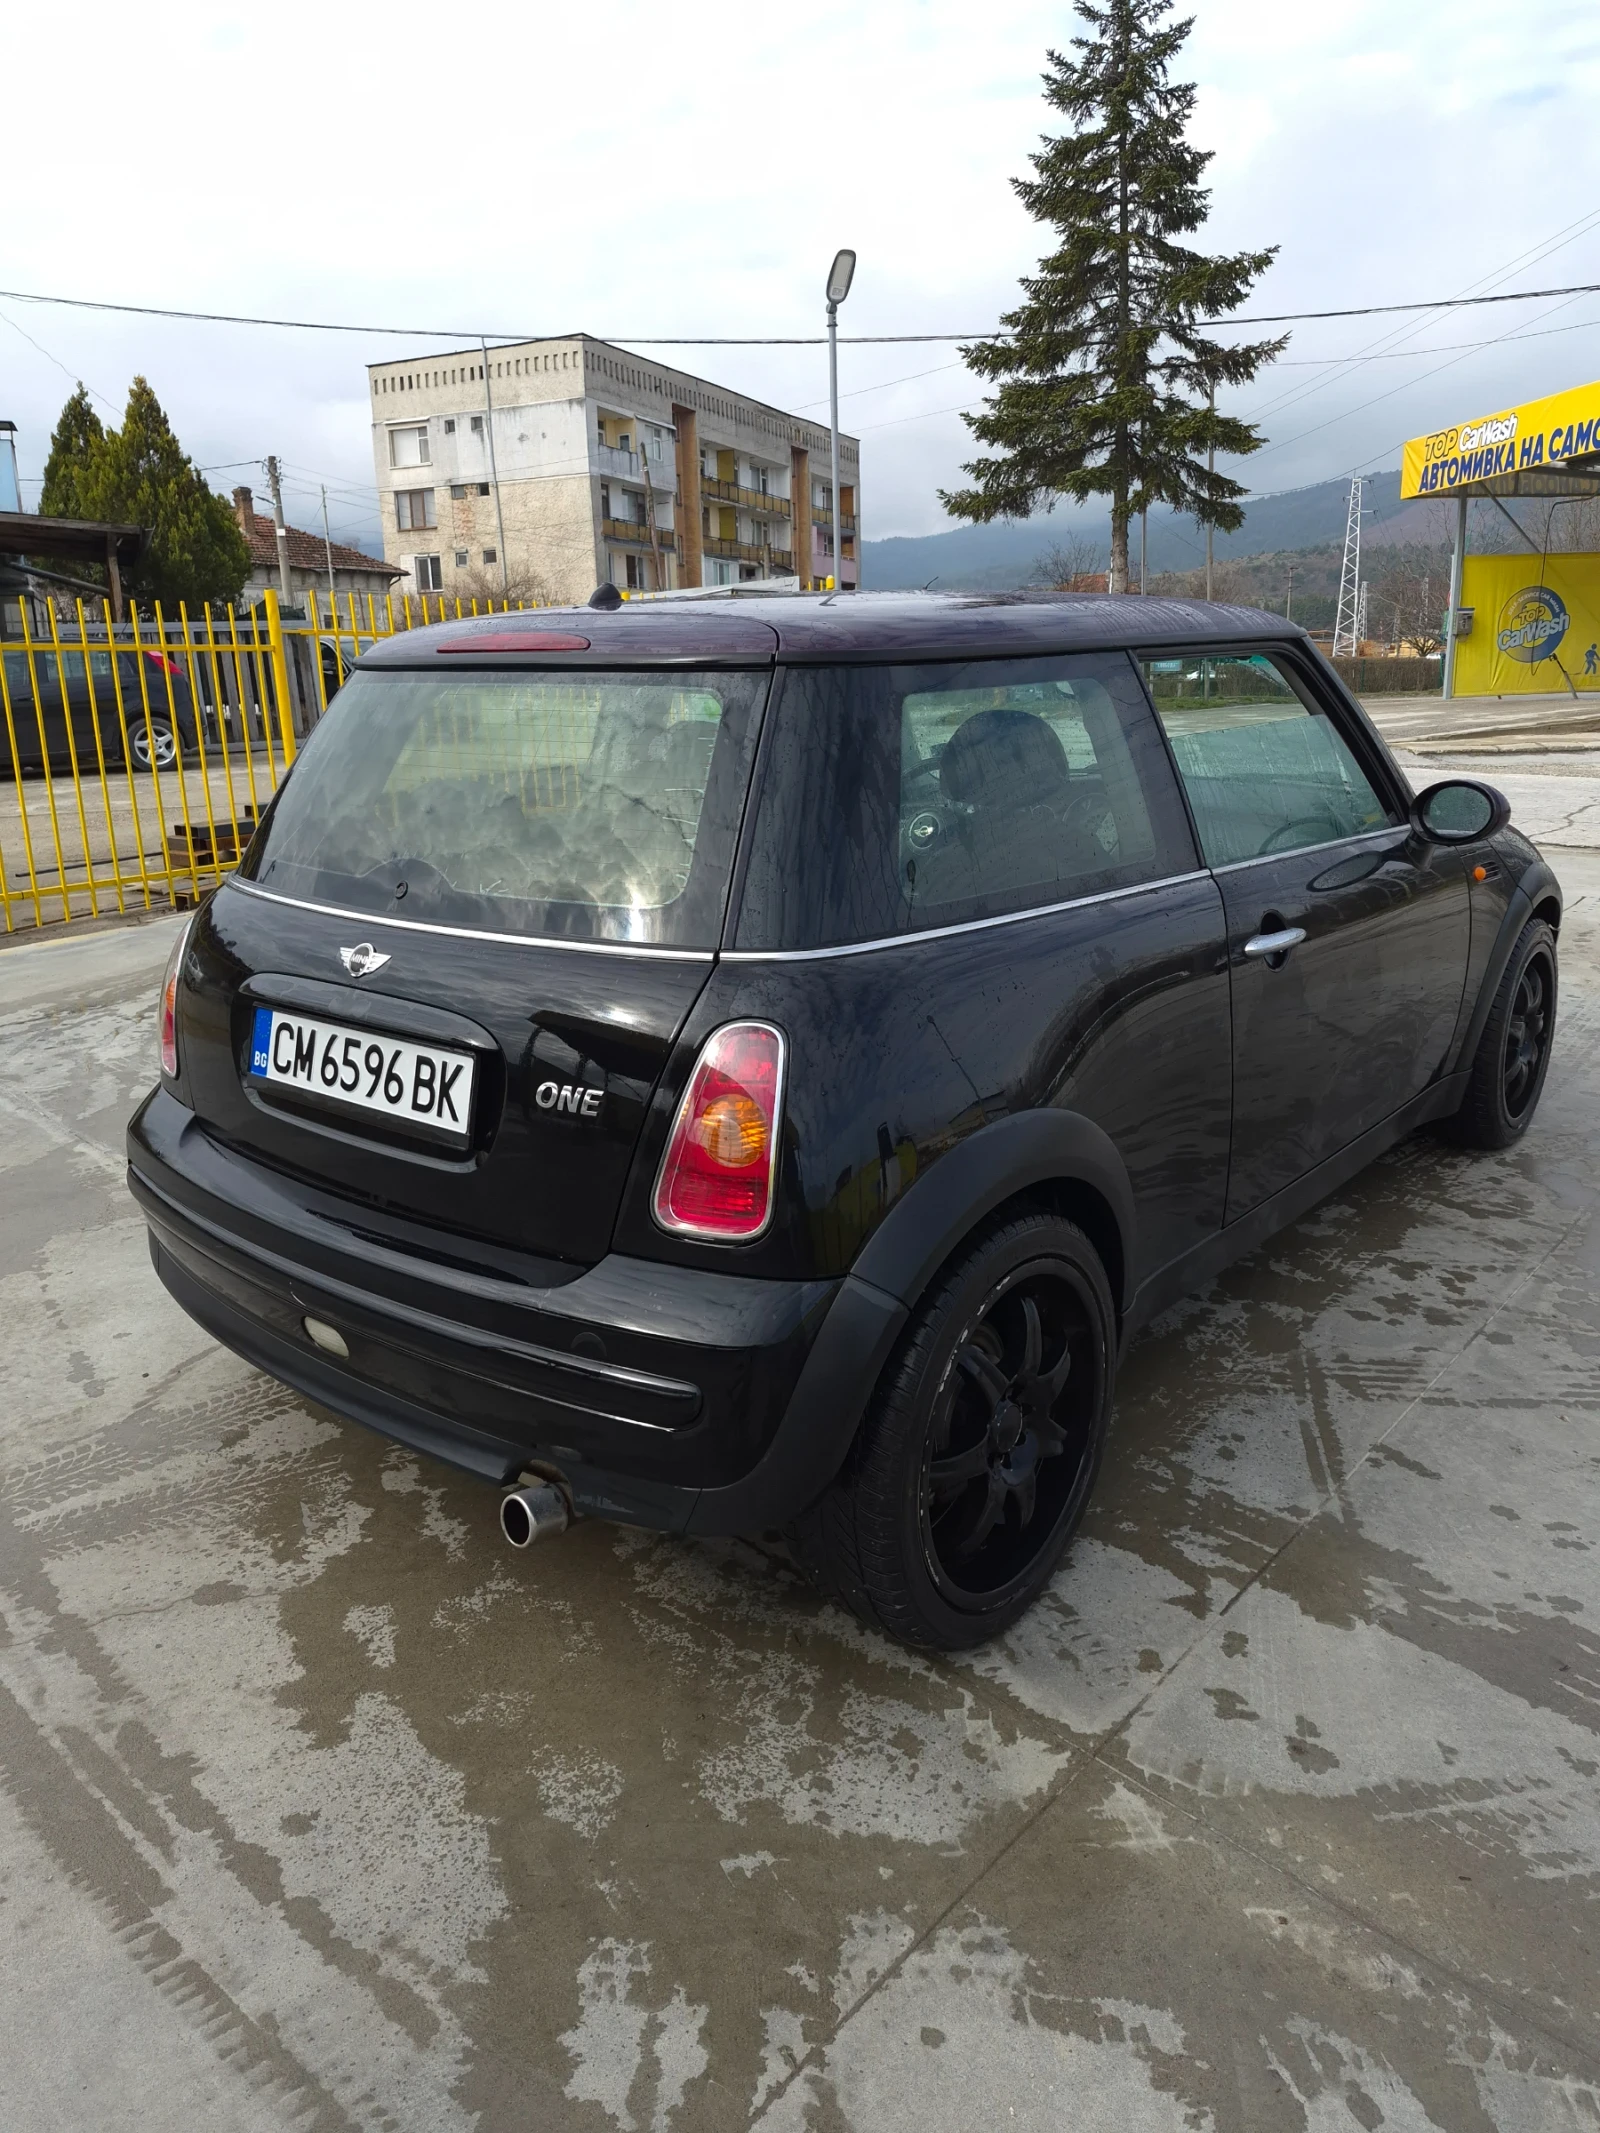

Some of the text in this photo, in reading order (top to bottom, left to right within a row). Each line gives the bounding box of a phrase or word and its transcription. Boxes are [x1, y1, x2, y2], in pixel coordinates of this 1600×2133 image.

[1425, 413, 1518, 461] TOP CarWash
[1418, 441, 1515, 493] АВТОМИВКА
[1519, 433, 1543, 467] НА
[1497, 612, 1570, 651] CarWash
[1519, 606, 1545, 625] TOP
[254, 1051, 267, 1068] BG
[535, 1081, 604, 1117] ONE
